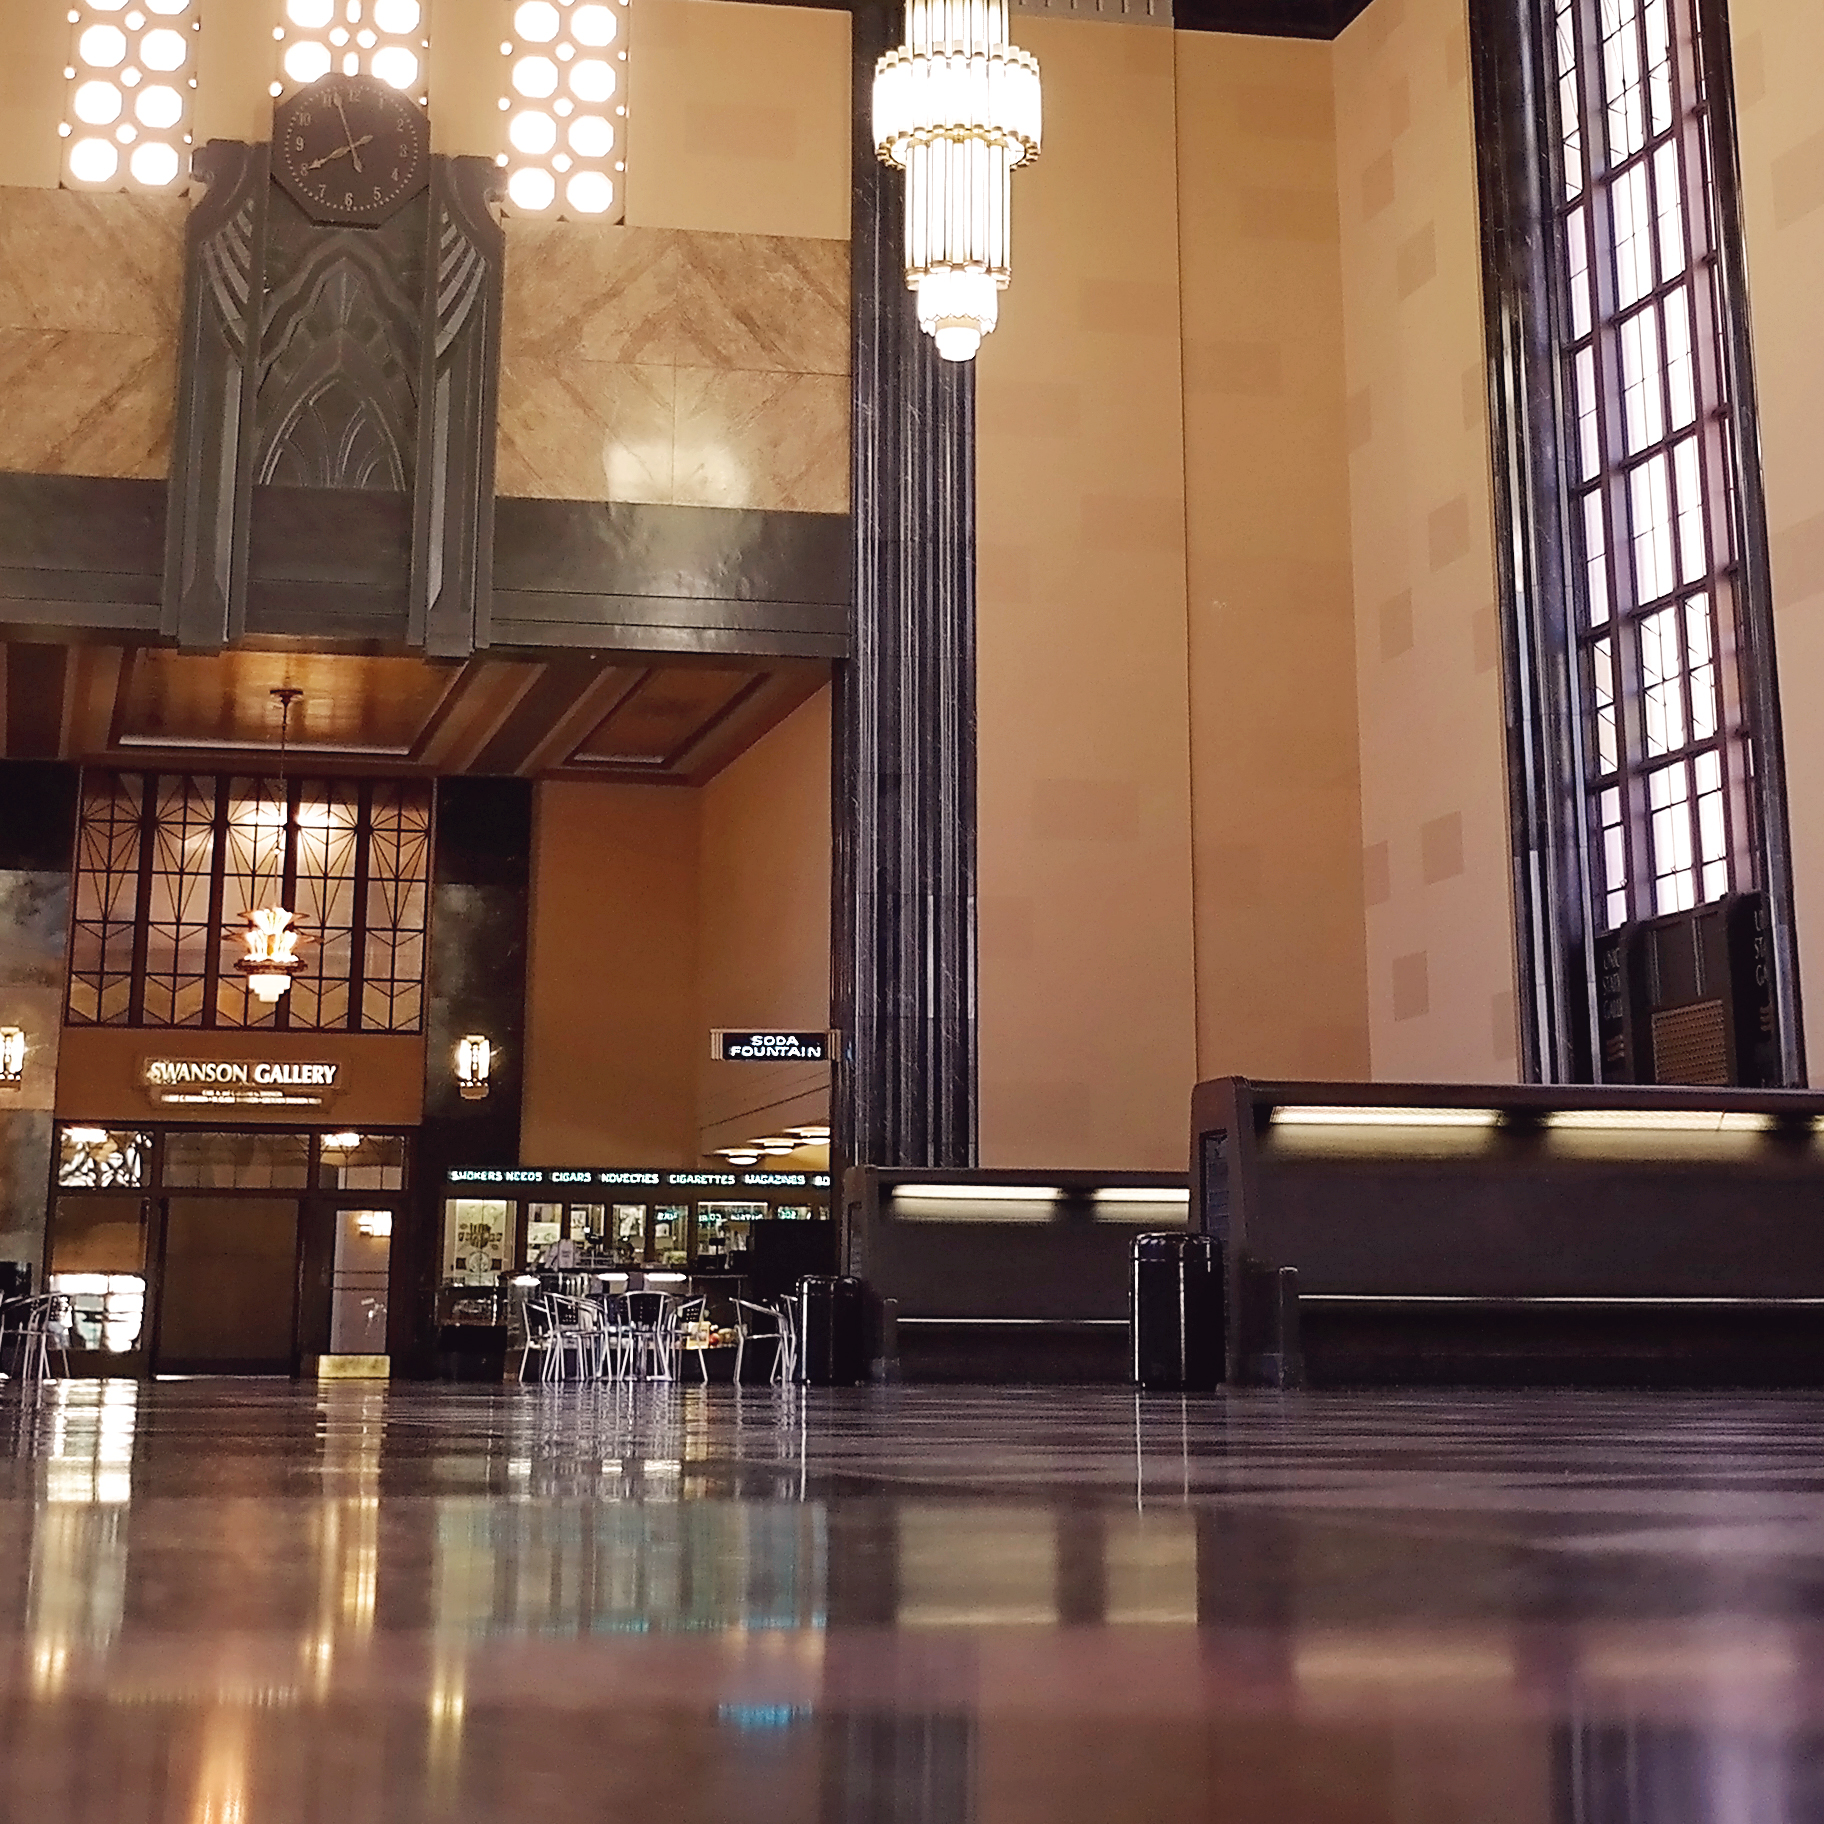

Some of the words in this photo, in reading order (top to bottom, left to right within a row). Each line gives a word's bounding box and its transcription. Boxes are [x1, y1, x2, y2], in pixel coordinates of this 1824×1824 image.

[299, 113, 312, 127] 10
[396, 118, 405, 132] 2
[296, 136, 305, 152] 9
[400, 143, 408, 158] 3
[300, 163, 309, 177] 8
[391, 168, 399, 182] 4
[318, 184, 327, 198] 7
[373, 187, 382, 201] 5
[344, 192, 354, 207] 6
[751, 1035, 799, 1046] SODA
[729, 1045, 821, 1058] FOUNTAIN
[149, 1062, 248, 1083] SWANSON
[253, 1063, 337, 1084] GALLERY
[505, 1171, 543, 1182] NEEDS
[551, 1172, 592, 1183] CIGARS
[669, 1174, 736, 1185] CIGARETTES
[744, 1174, 806, 1186] MAGAZINES
